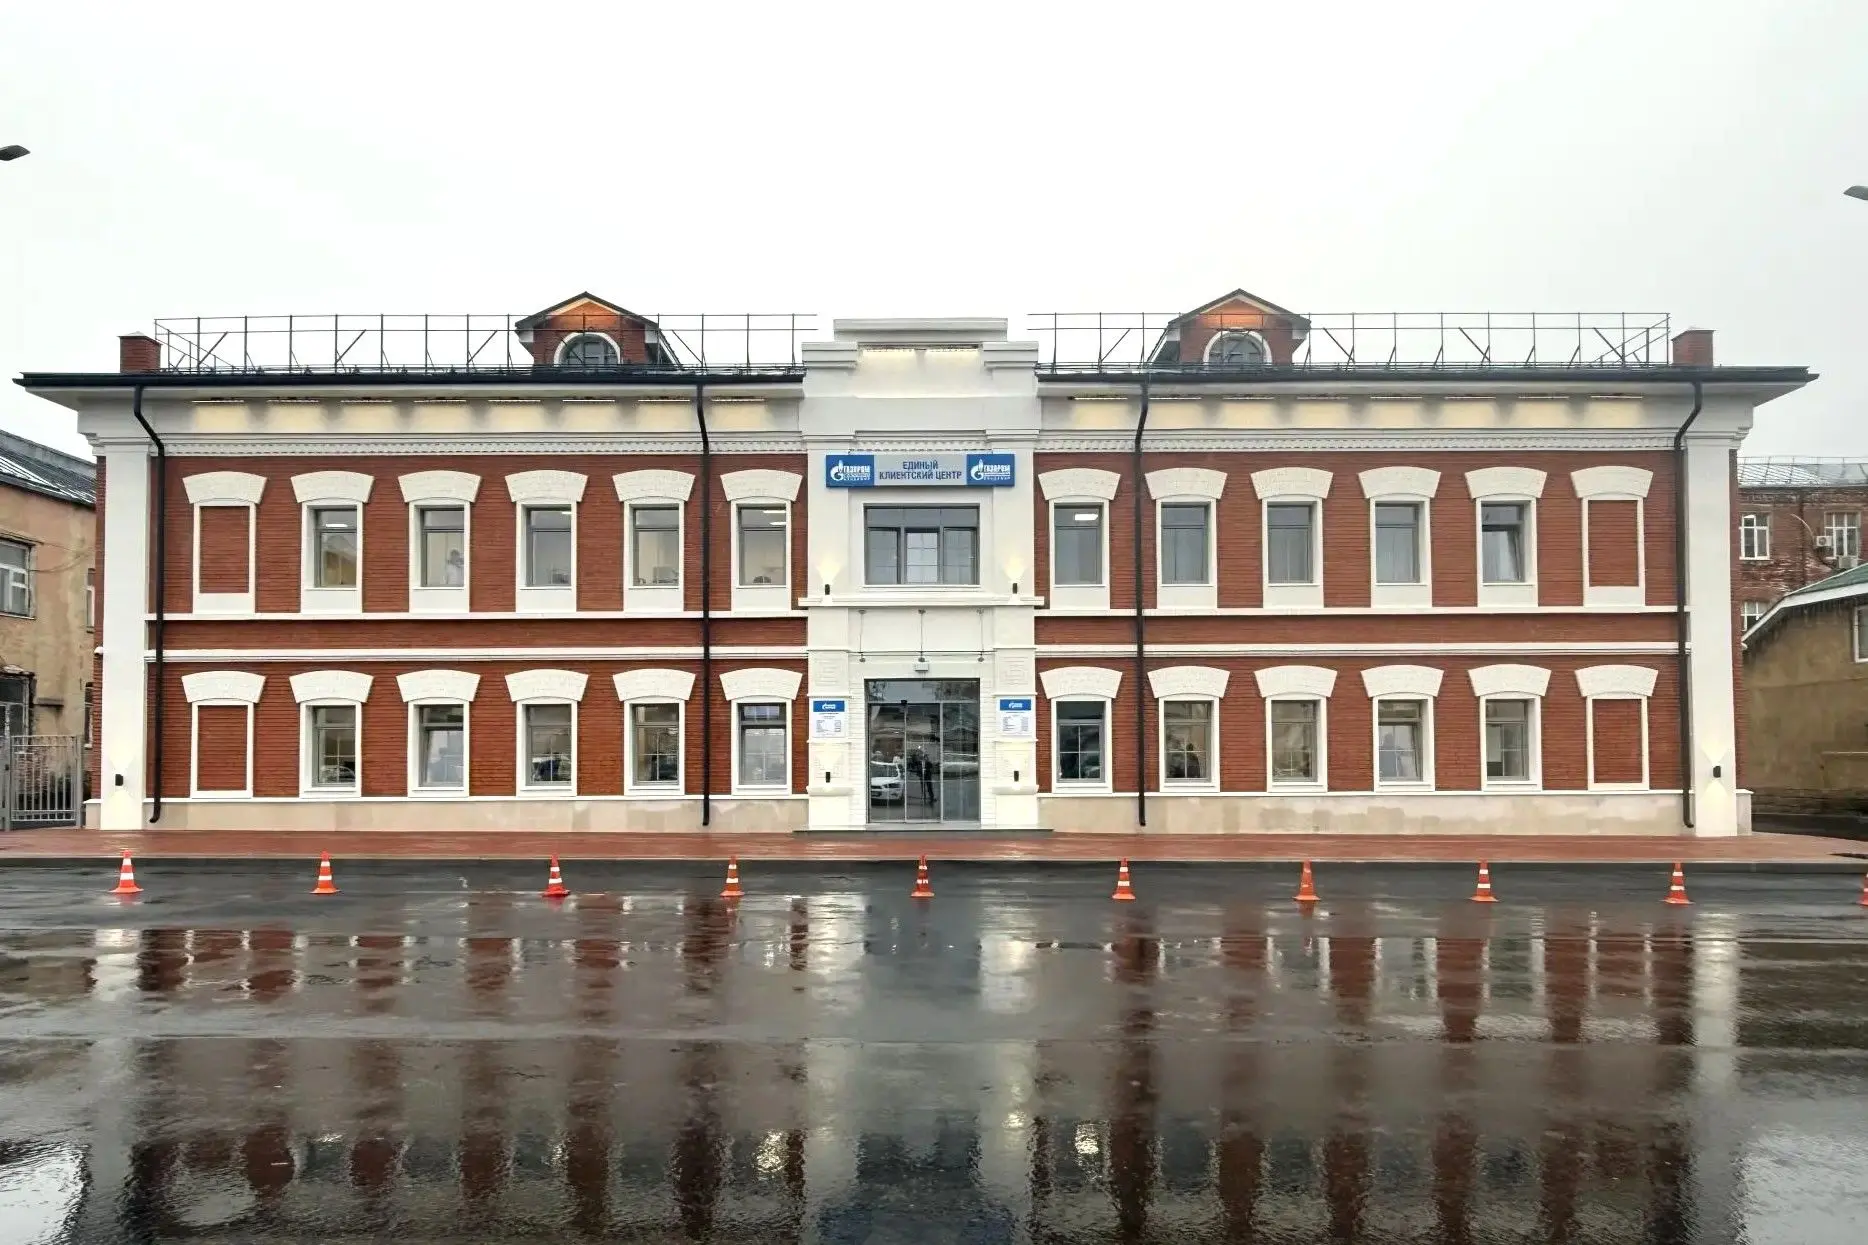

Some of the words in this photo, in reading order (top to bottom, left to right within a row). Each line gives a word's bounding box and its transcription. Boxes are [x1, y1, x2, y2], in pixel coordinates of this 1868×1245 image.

[902, 460, 939, 470] ЕДИНЫЙ
[879, 471, 934, 480] КЛИЕНТСКИЙ
[935, 471, 962, 481] ЦЕНТР
